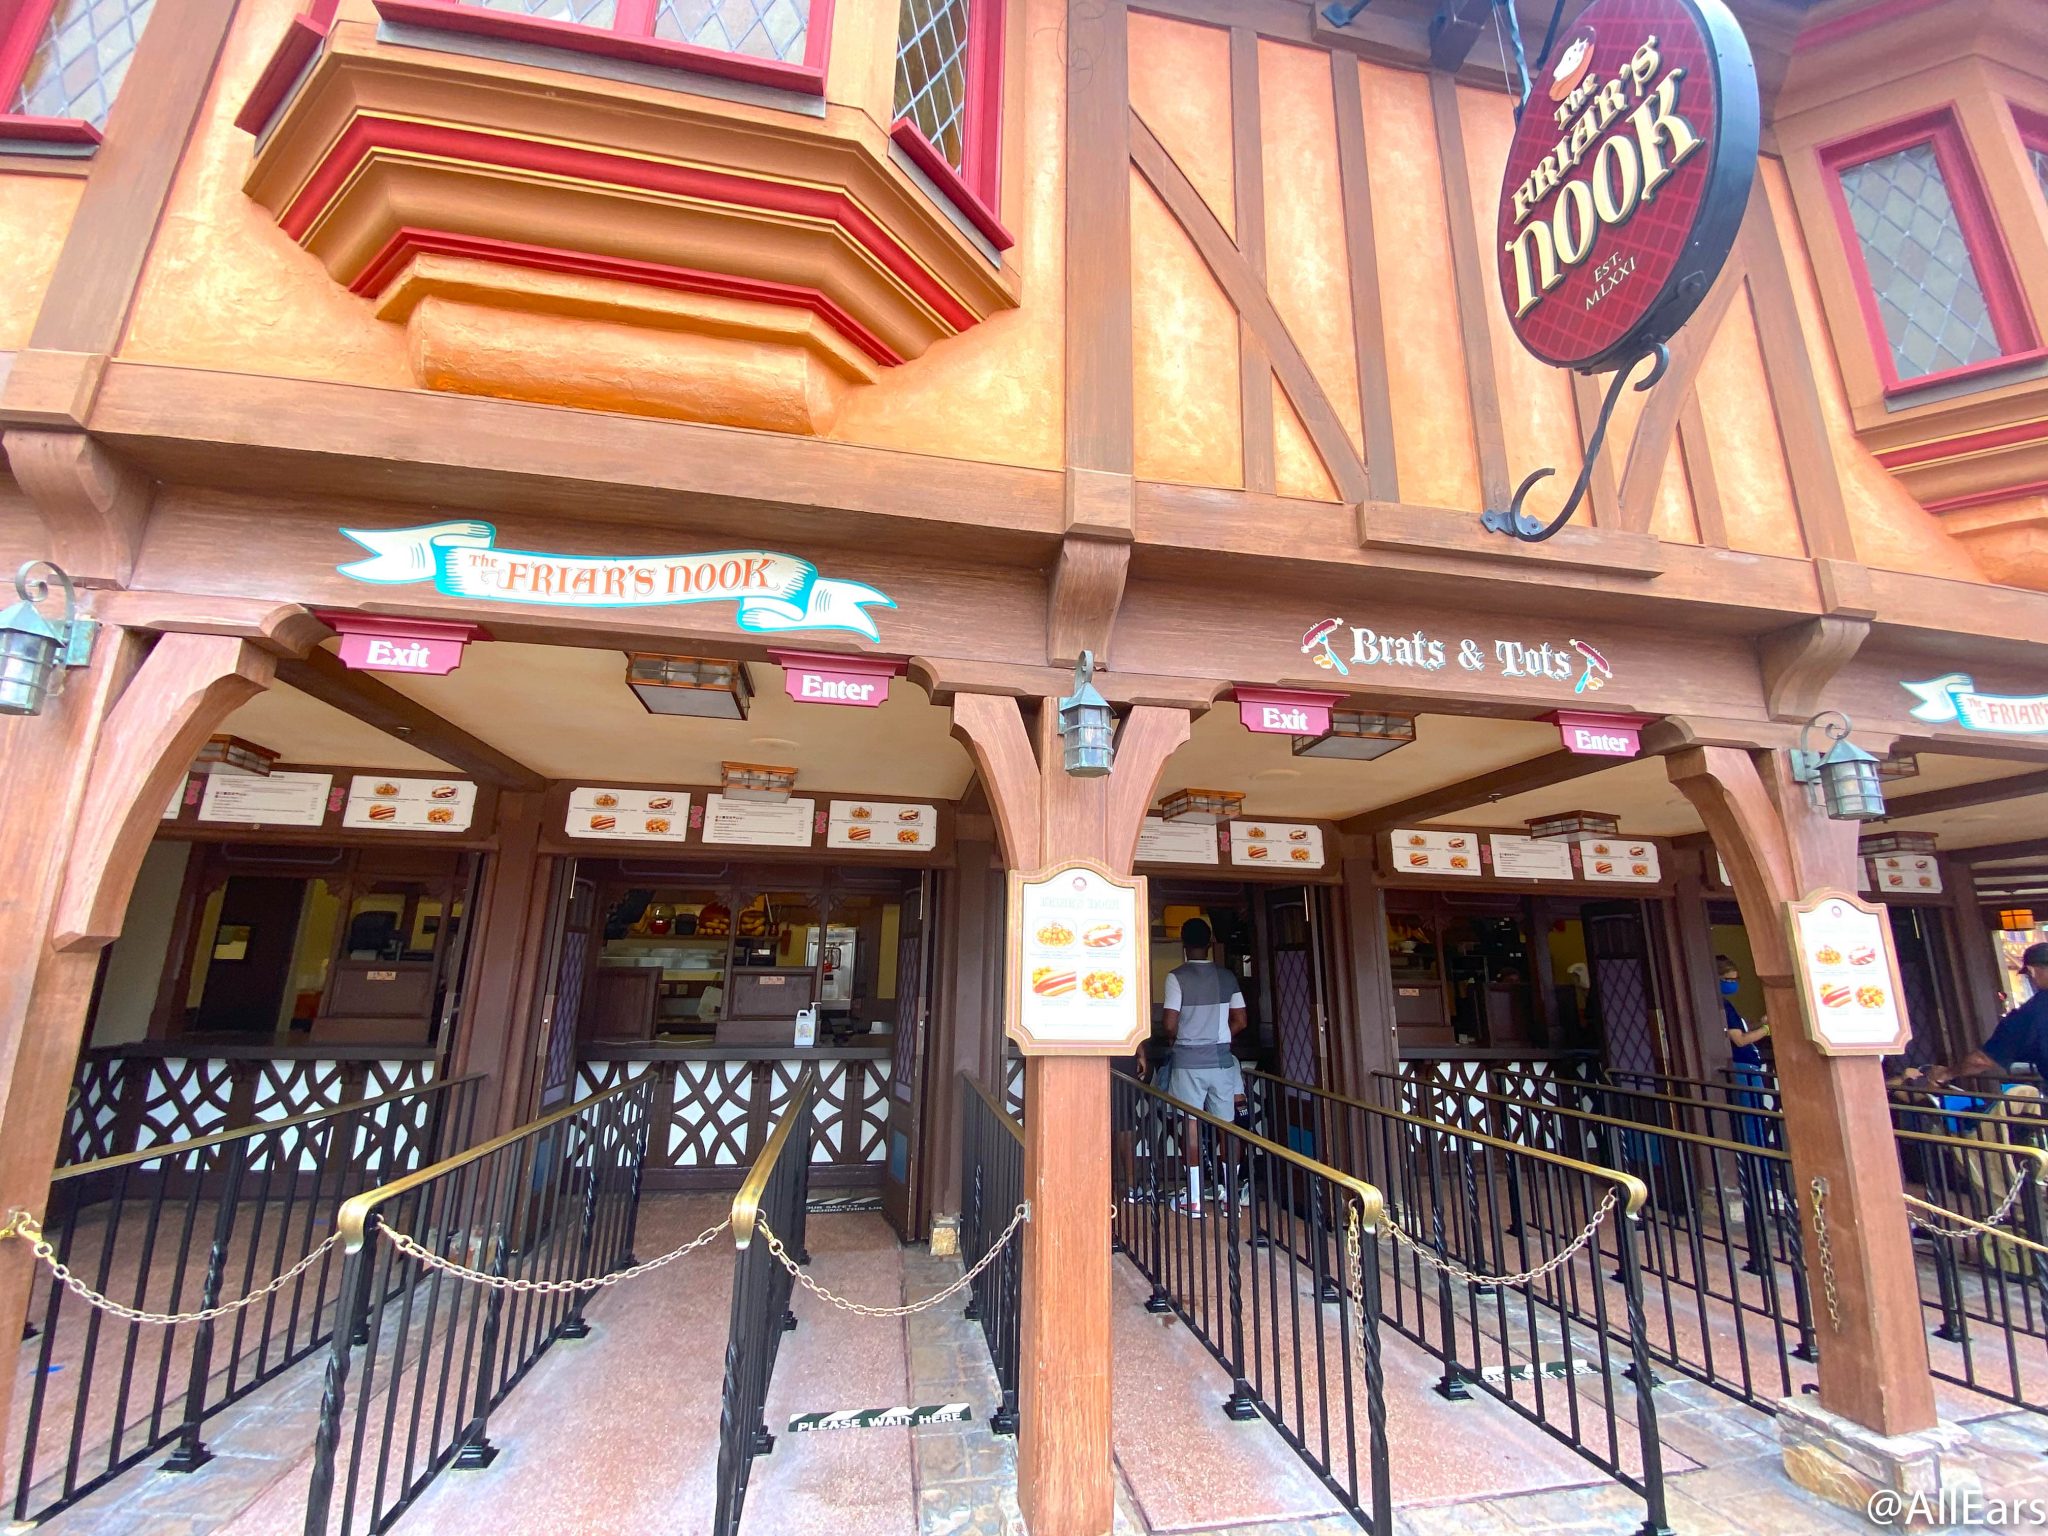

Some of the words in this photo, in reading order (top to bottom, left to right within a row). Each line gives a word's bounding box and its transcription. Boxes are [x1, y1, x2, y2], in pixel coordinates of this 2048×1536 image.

[1511, 34, 1661, 225] FRIAR'S
[1593, 251, 1622, 283] EST.
[1585, 256, 1637, 311] MLXXI
[469, 553, 498, 568] The
[497, 560, 657, 600] FRIAR'S
[366, 640, 431, 669] Exit
[1349, 626, 1446, 671] Brats
[1458, 638, 1486, 672] &
[1495, 638, 1574, 682] Tots
[800, 674, 875, 702] Enter
[1261, 707, 1309, 732] Exit
[1986, 701, 2048, 726] FRIAR'
[1574, 730, 1630, 753] Enter
[797, 1418, 861, 1432] PLEASE
[868, 1414, 912, 1427] WAIT
[918, 1412, 963, 1424] HERE
